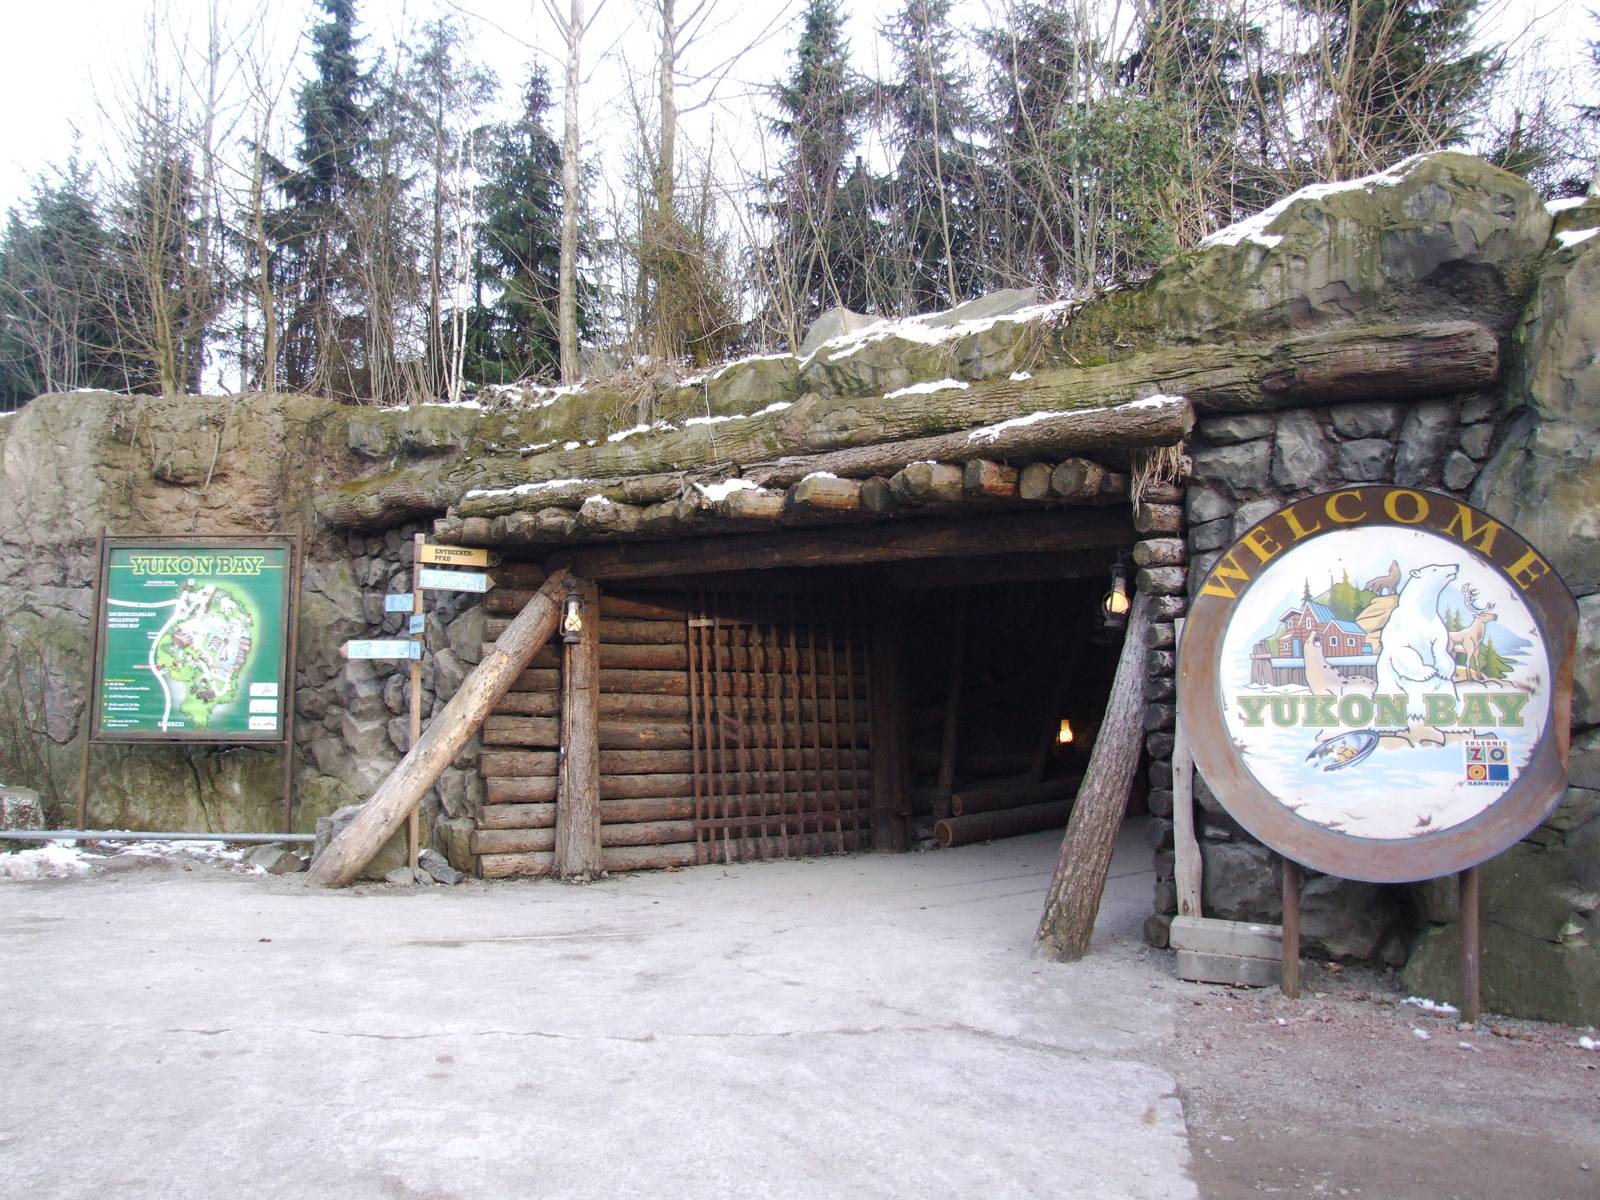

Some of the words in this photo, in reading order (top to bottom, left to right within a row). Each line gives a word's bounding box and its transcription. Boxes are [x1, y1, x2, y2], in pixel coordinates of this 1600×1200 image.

[1200, 489, 1551, 600] WELCOME
[131, 556, 216, 575] YUKON
[217, 556, 264, 575] BAY
[1236, 693, 1409, 728] YUKON
[1423, 692, 1529, 728] BAY
